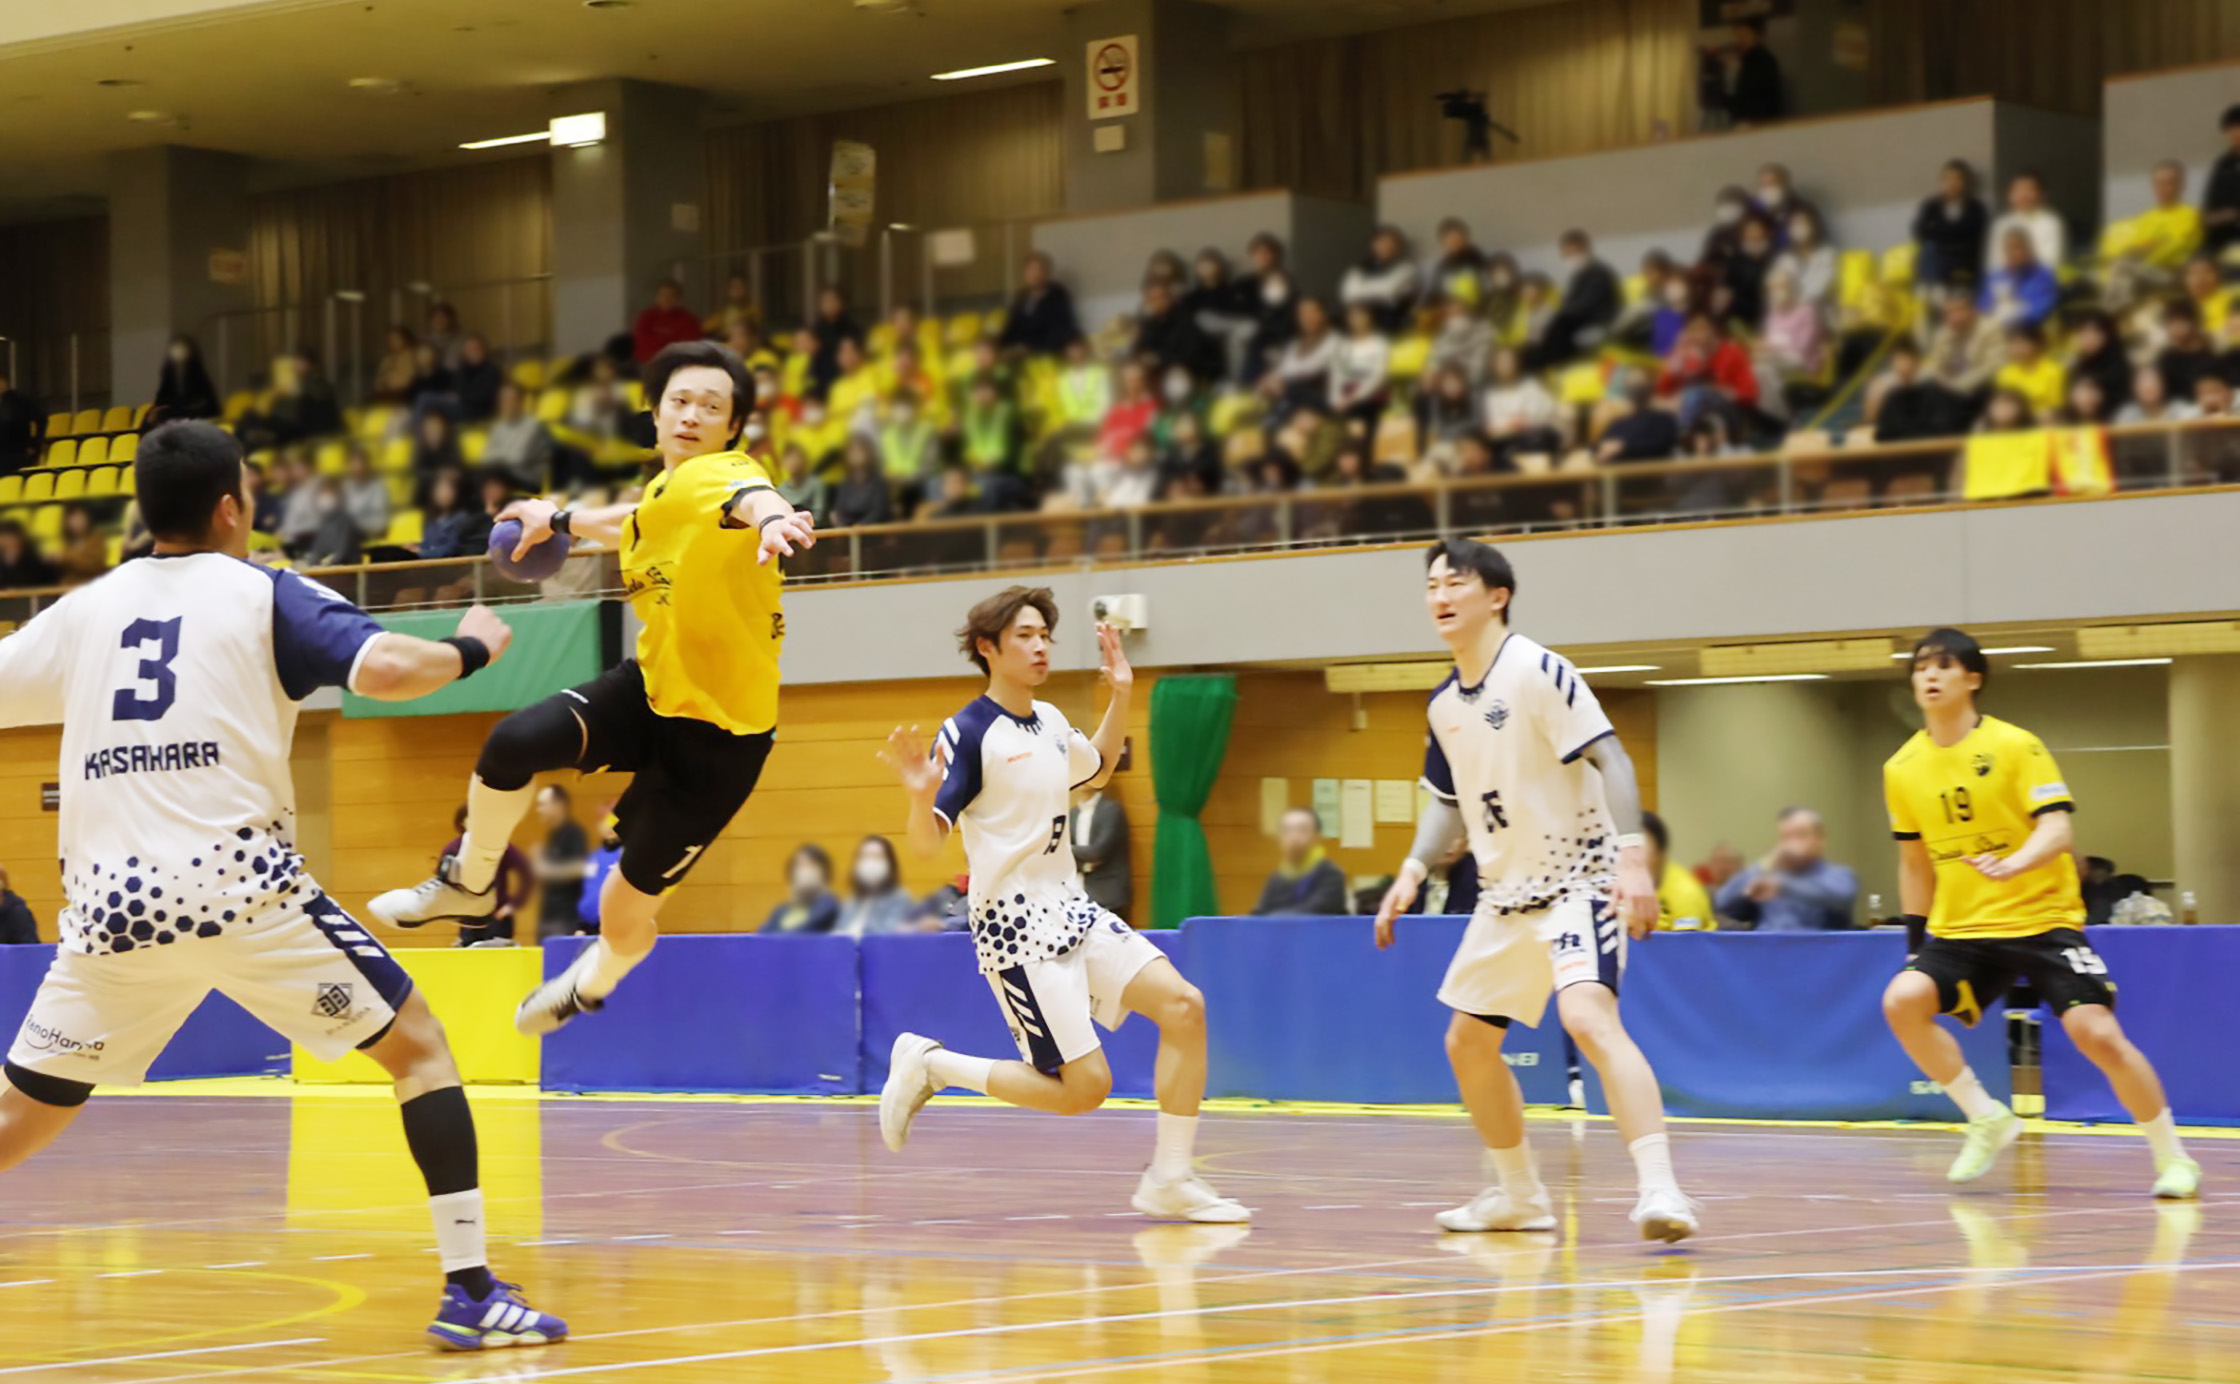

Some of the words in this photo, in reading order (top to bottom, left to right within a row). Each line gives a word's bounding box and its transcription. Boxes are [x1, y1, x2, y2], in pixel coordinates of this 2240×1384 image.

[112, 615, 183, 722] 3
[84, 740, 220, 781] KASAHARA
[1940, 786, 1974, 824] 19
